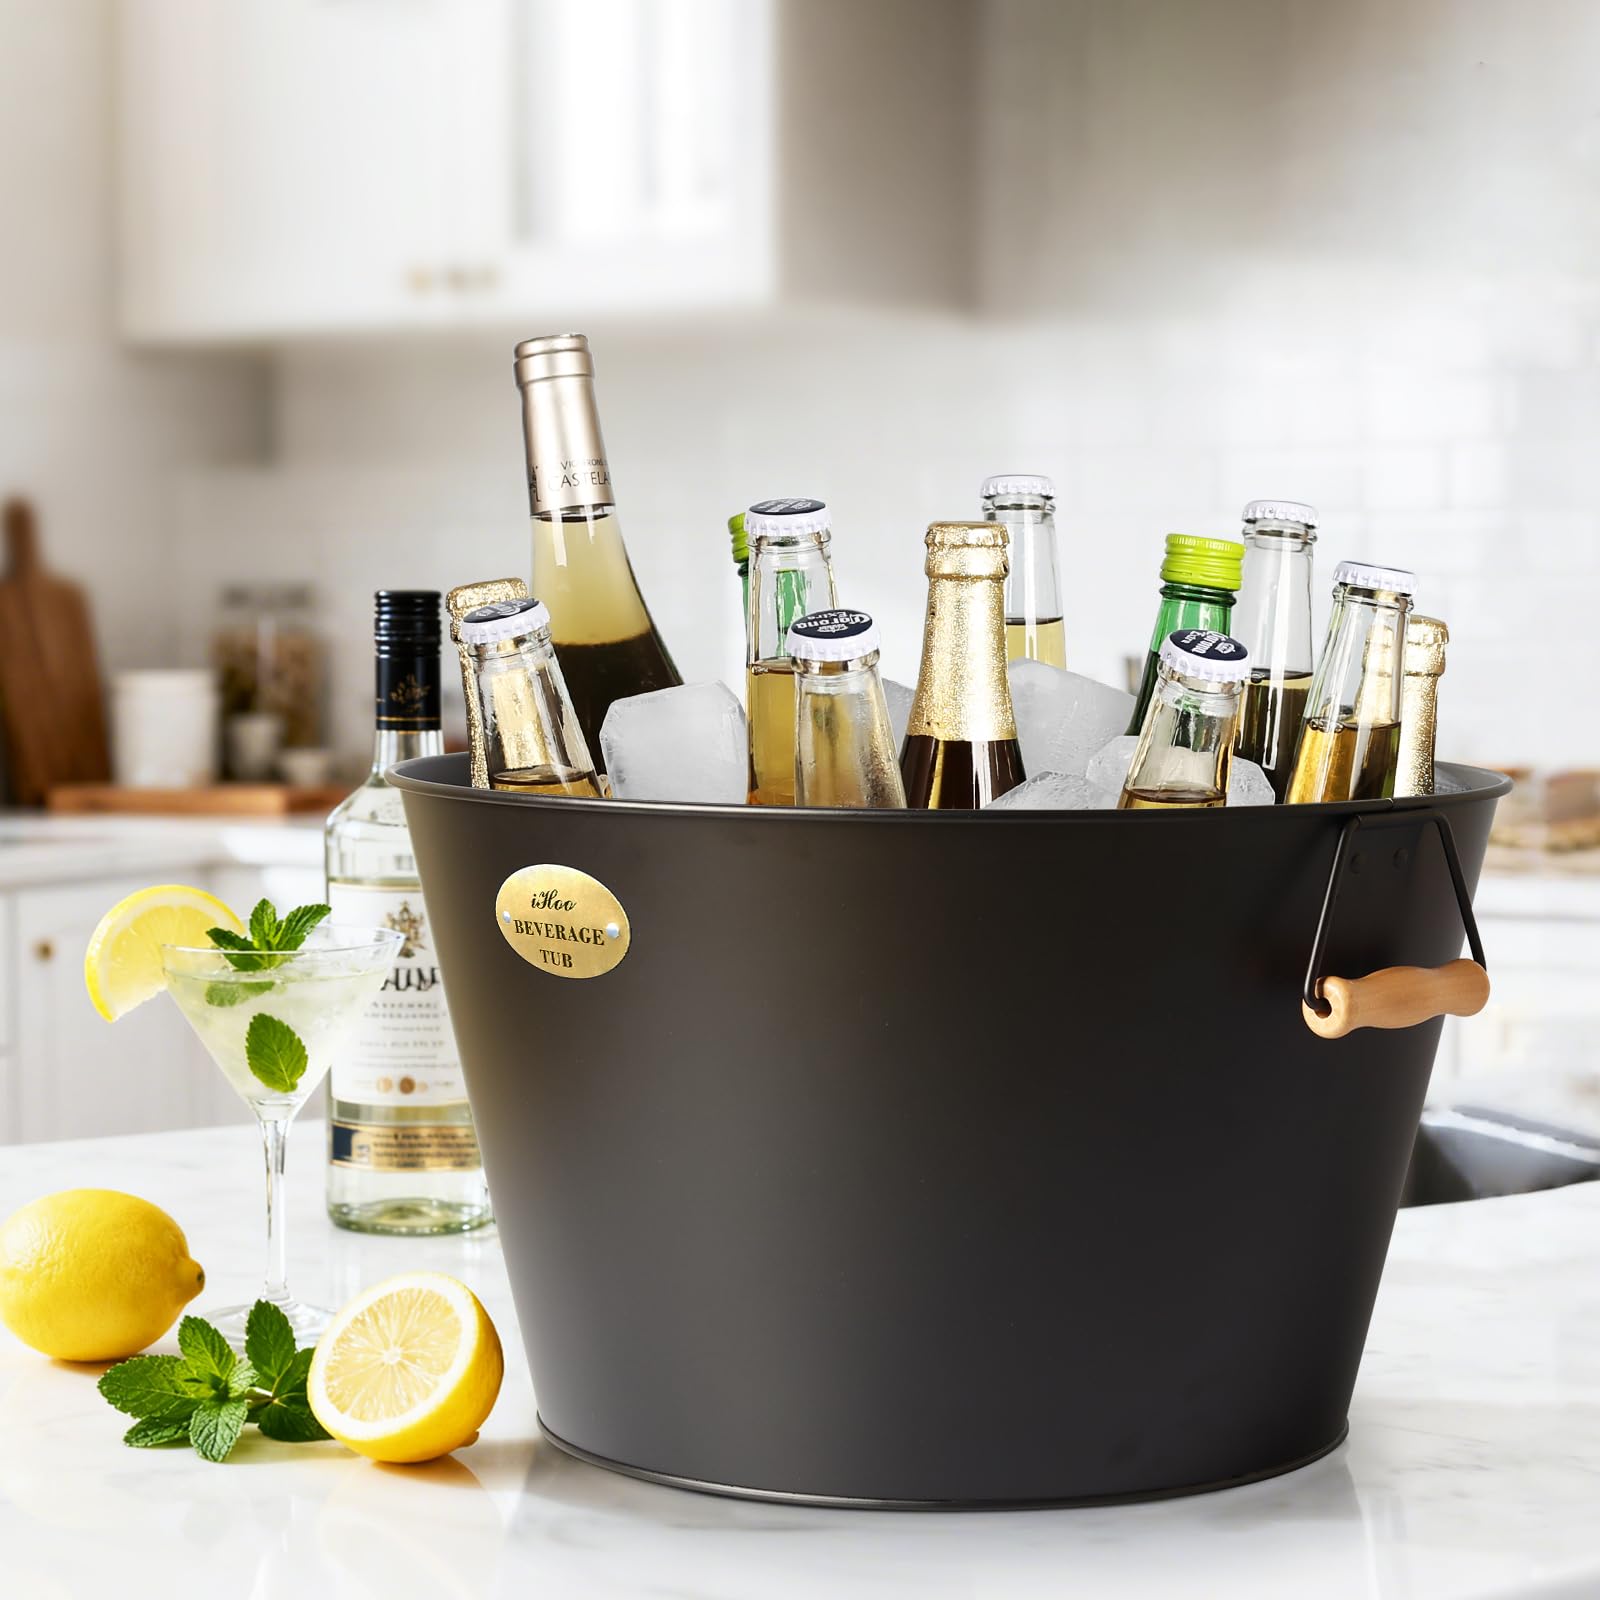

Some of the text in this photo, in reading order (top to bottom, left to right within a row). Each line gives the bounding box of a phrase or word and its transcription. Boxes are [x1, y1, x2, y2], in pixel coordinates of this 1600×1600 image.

[796, 613, 871, 629] Corona
[514, 920, 605, 946] BEVERAGE
[539, 949, 573, 968] TUB
